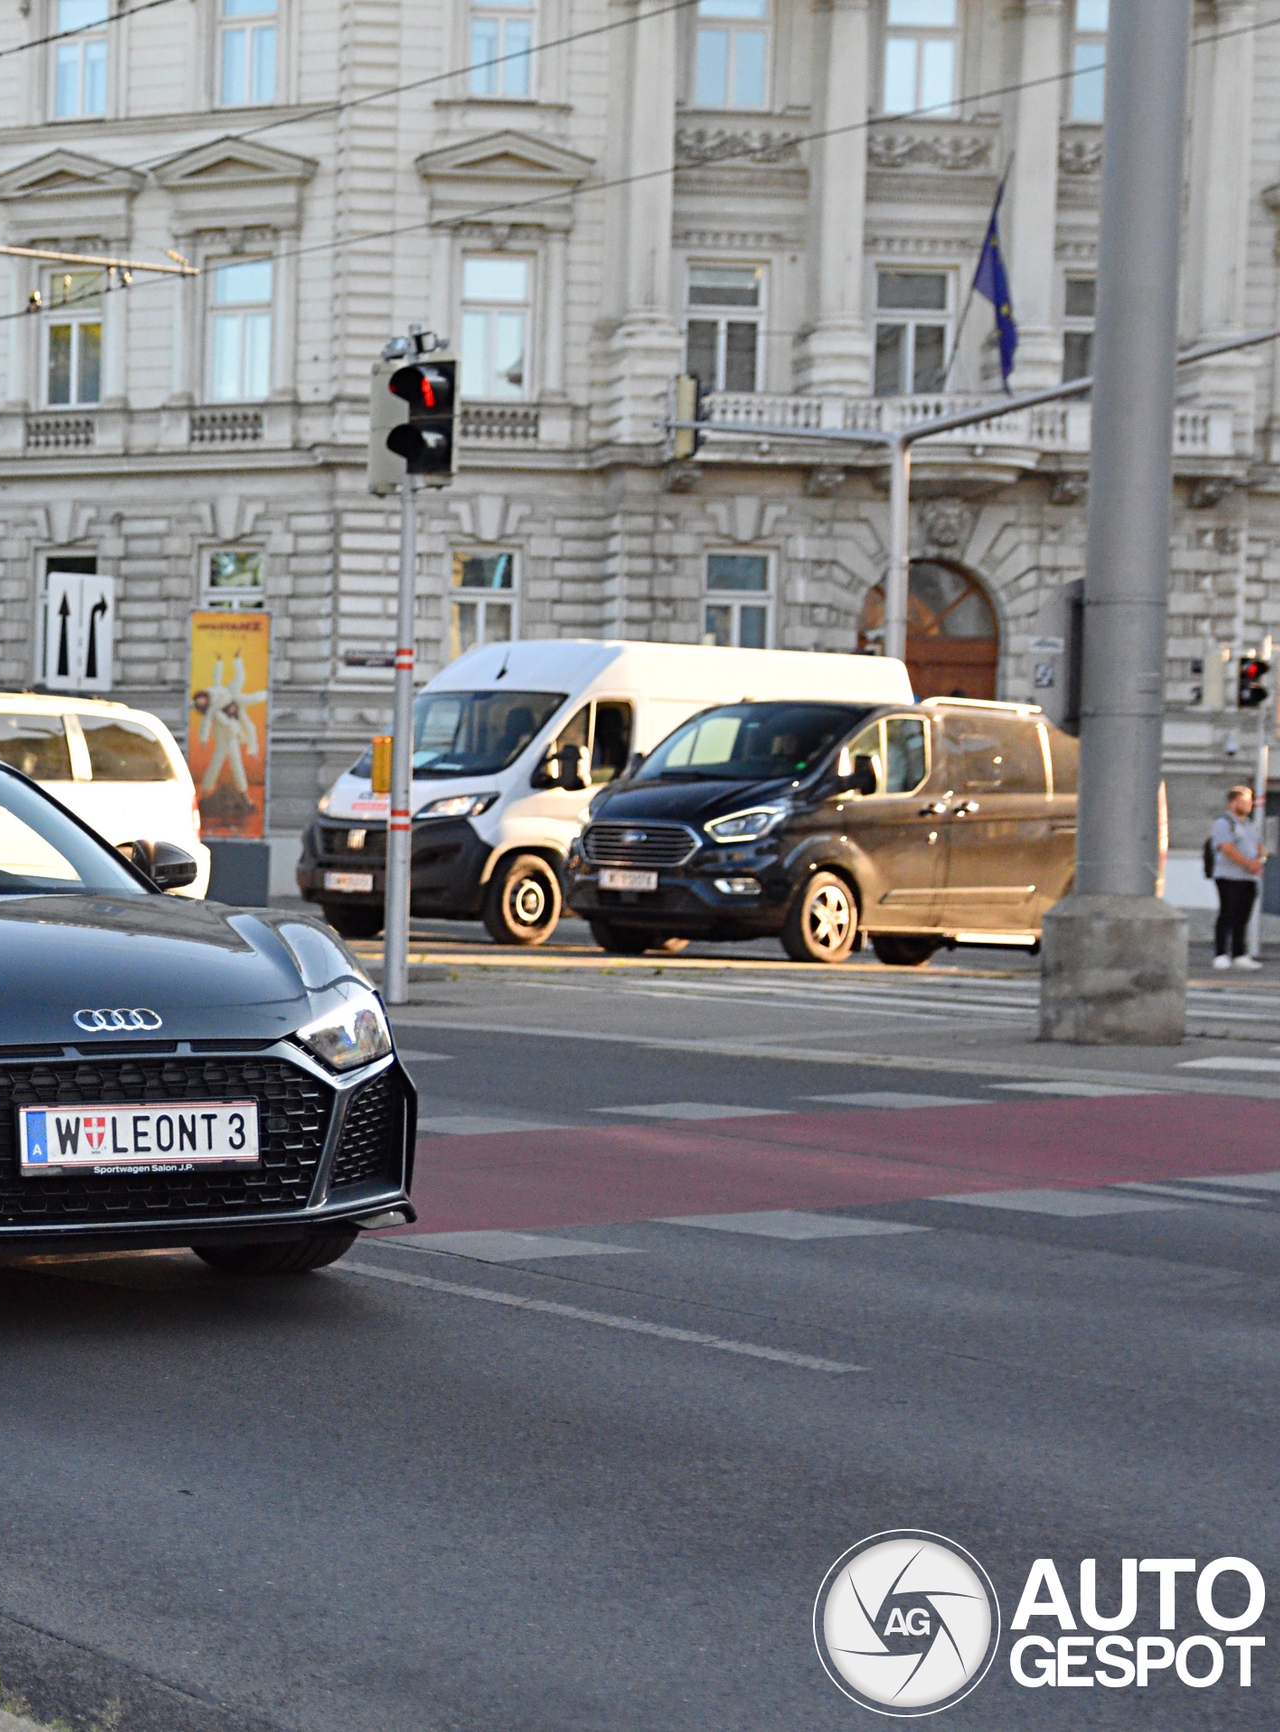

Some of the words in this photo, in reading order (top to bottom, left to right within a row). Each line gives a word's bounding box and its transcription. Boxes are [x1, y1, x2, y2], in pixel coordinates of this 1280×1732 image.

[55, 1116, 81, 1155] W
[111, 1113, 218, 1153] LEONT
[228, 1112, 246, 1150] 3
[32, 1143, 43, 1156] A
[93, 1165, 150, 1175] Sportwagen
[151, 1164, 177, 1172] Salon
[178, 1163, 195, 1171] J.P.
